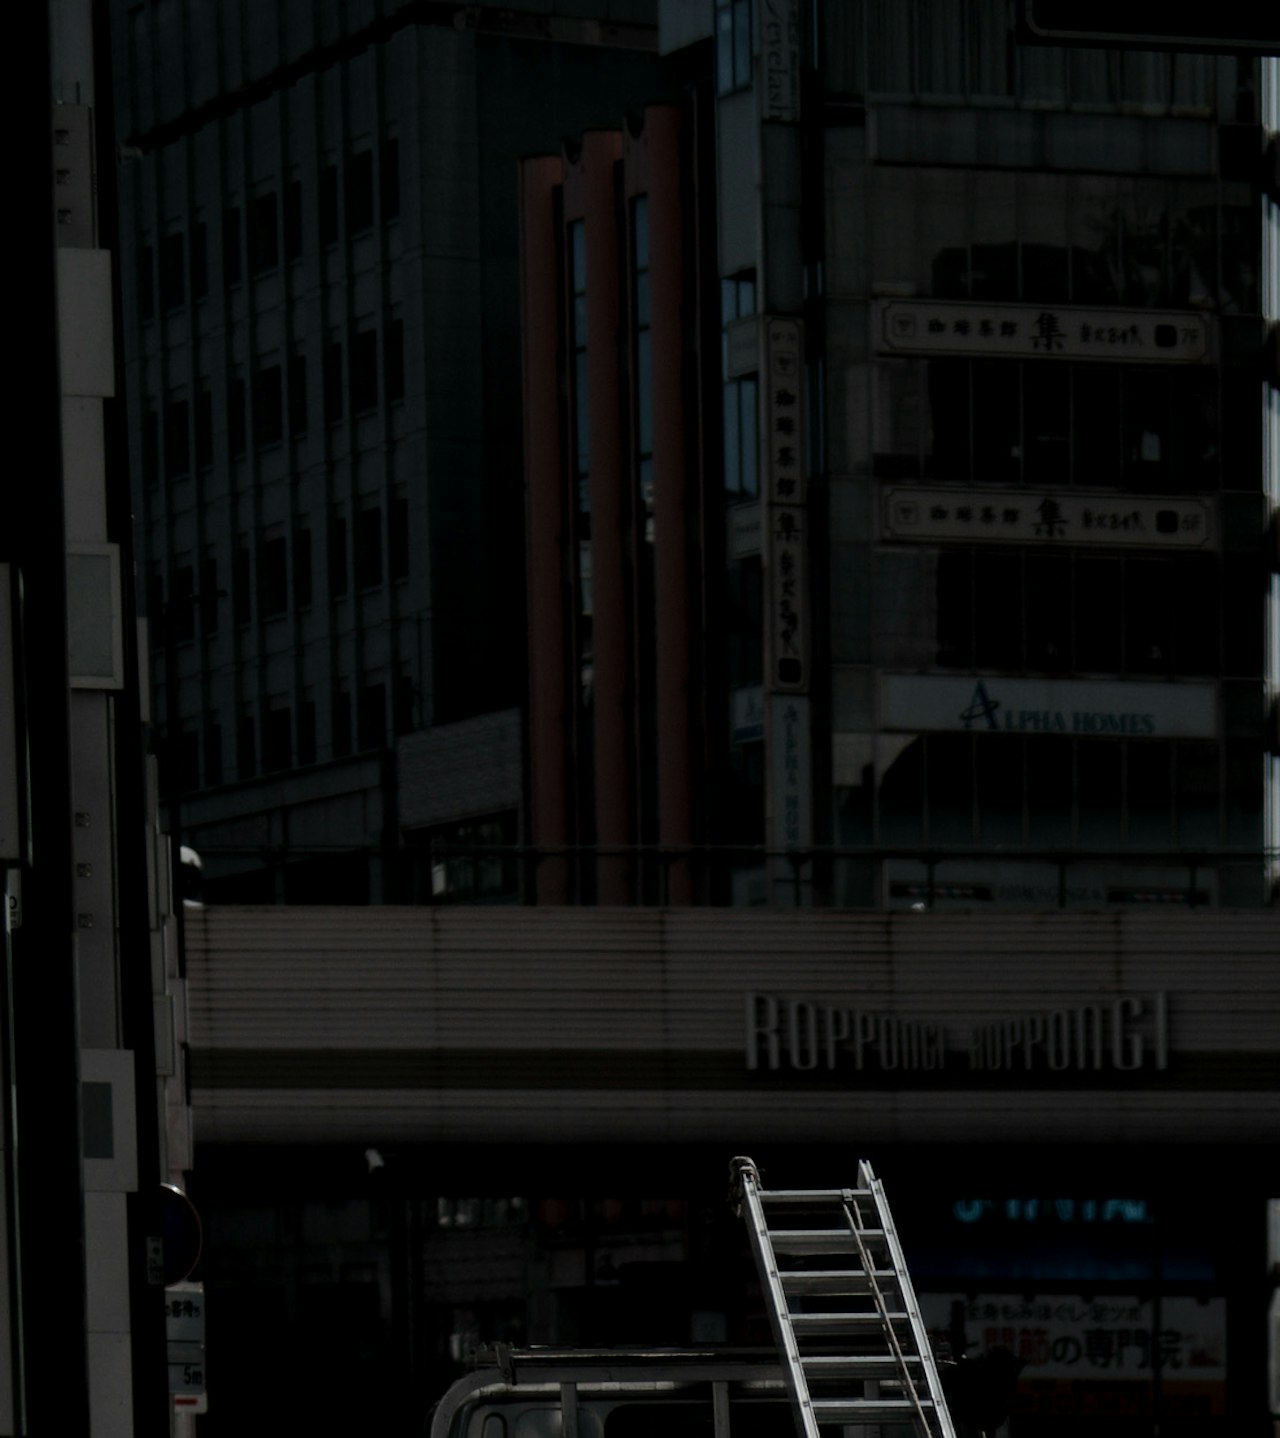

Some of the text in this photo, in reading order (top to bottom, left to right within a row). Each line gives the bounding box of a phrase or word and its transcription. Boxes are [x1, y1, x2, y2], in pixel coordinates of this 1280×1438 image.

[1028, 311, 1067, 351] 集
[958, 679, 1156, 734] ALPHA HOMES
[744, 991, 1169, 1071] ROPPONGI ROPPONGI
